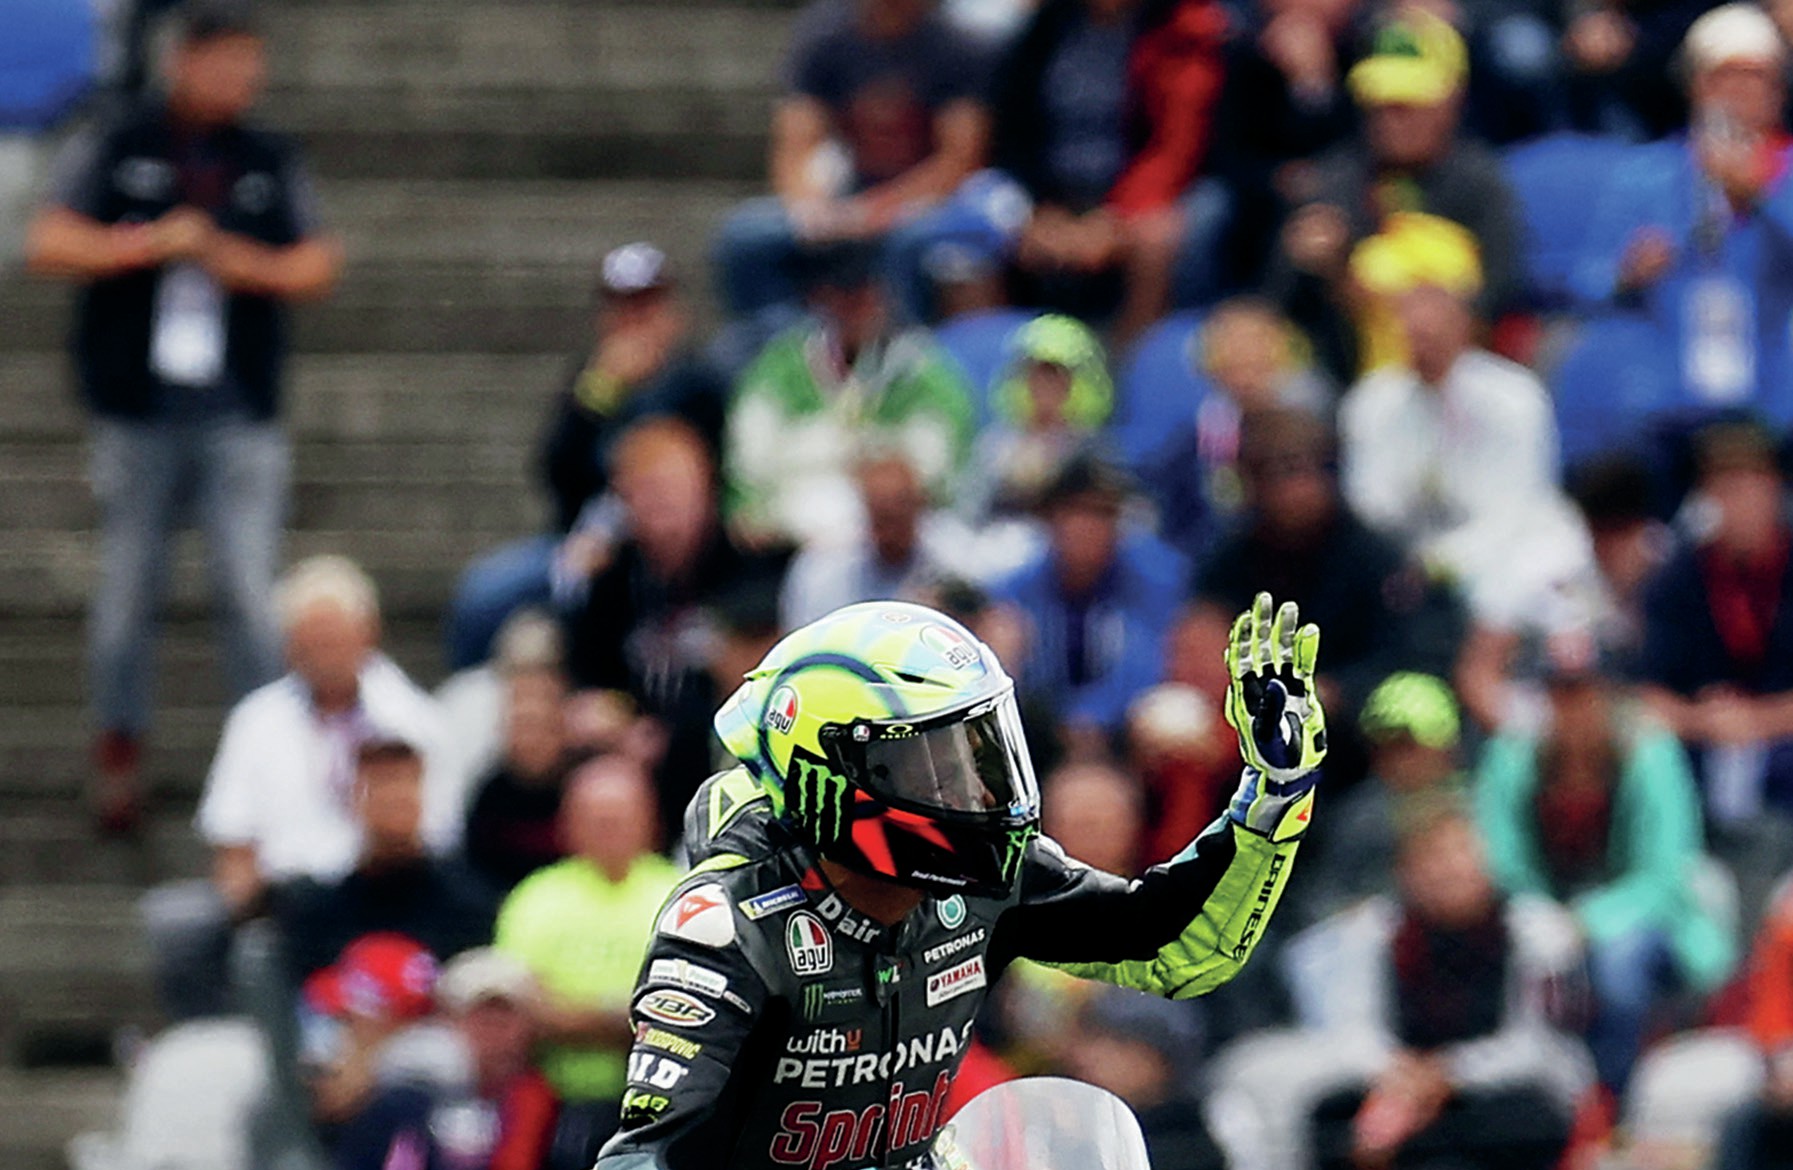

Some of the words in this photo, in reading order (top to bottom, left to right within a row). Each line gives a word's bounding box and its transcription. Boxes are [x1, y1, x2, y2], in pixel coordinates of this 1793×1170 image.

[797, 946, 826, 971] agv
[923, 927, 986, 964] PETRONAS
[940, 960, 982, 987] YAMAHA
